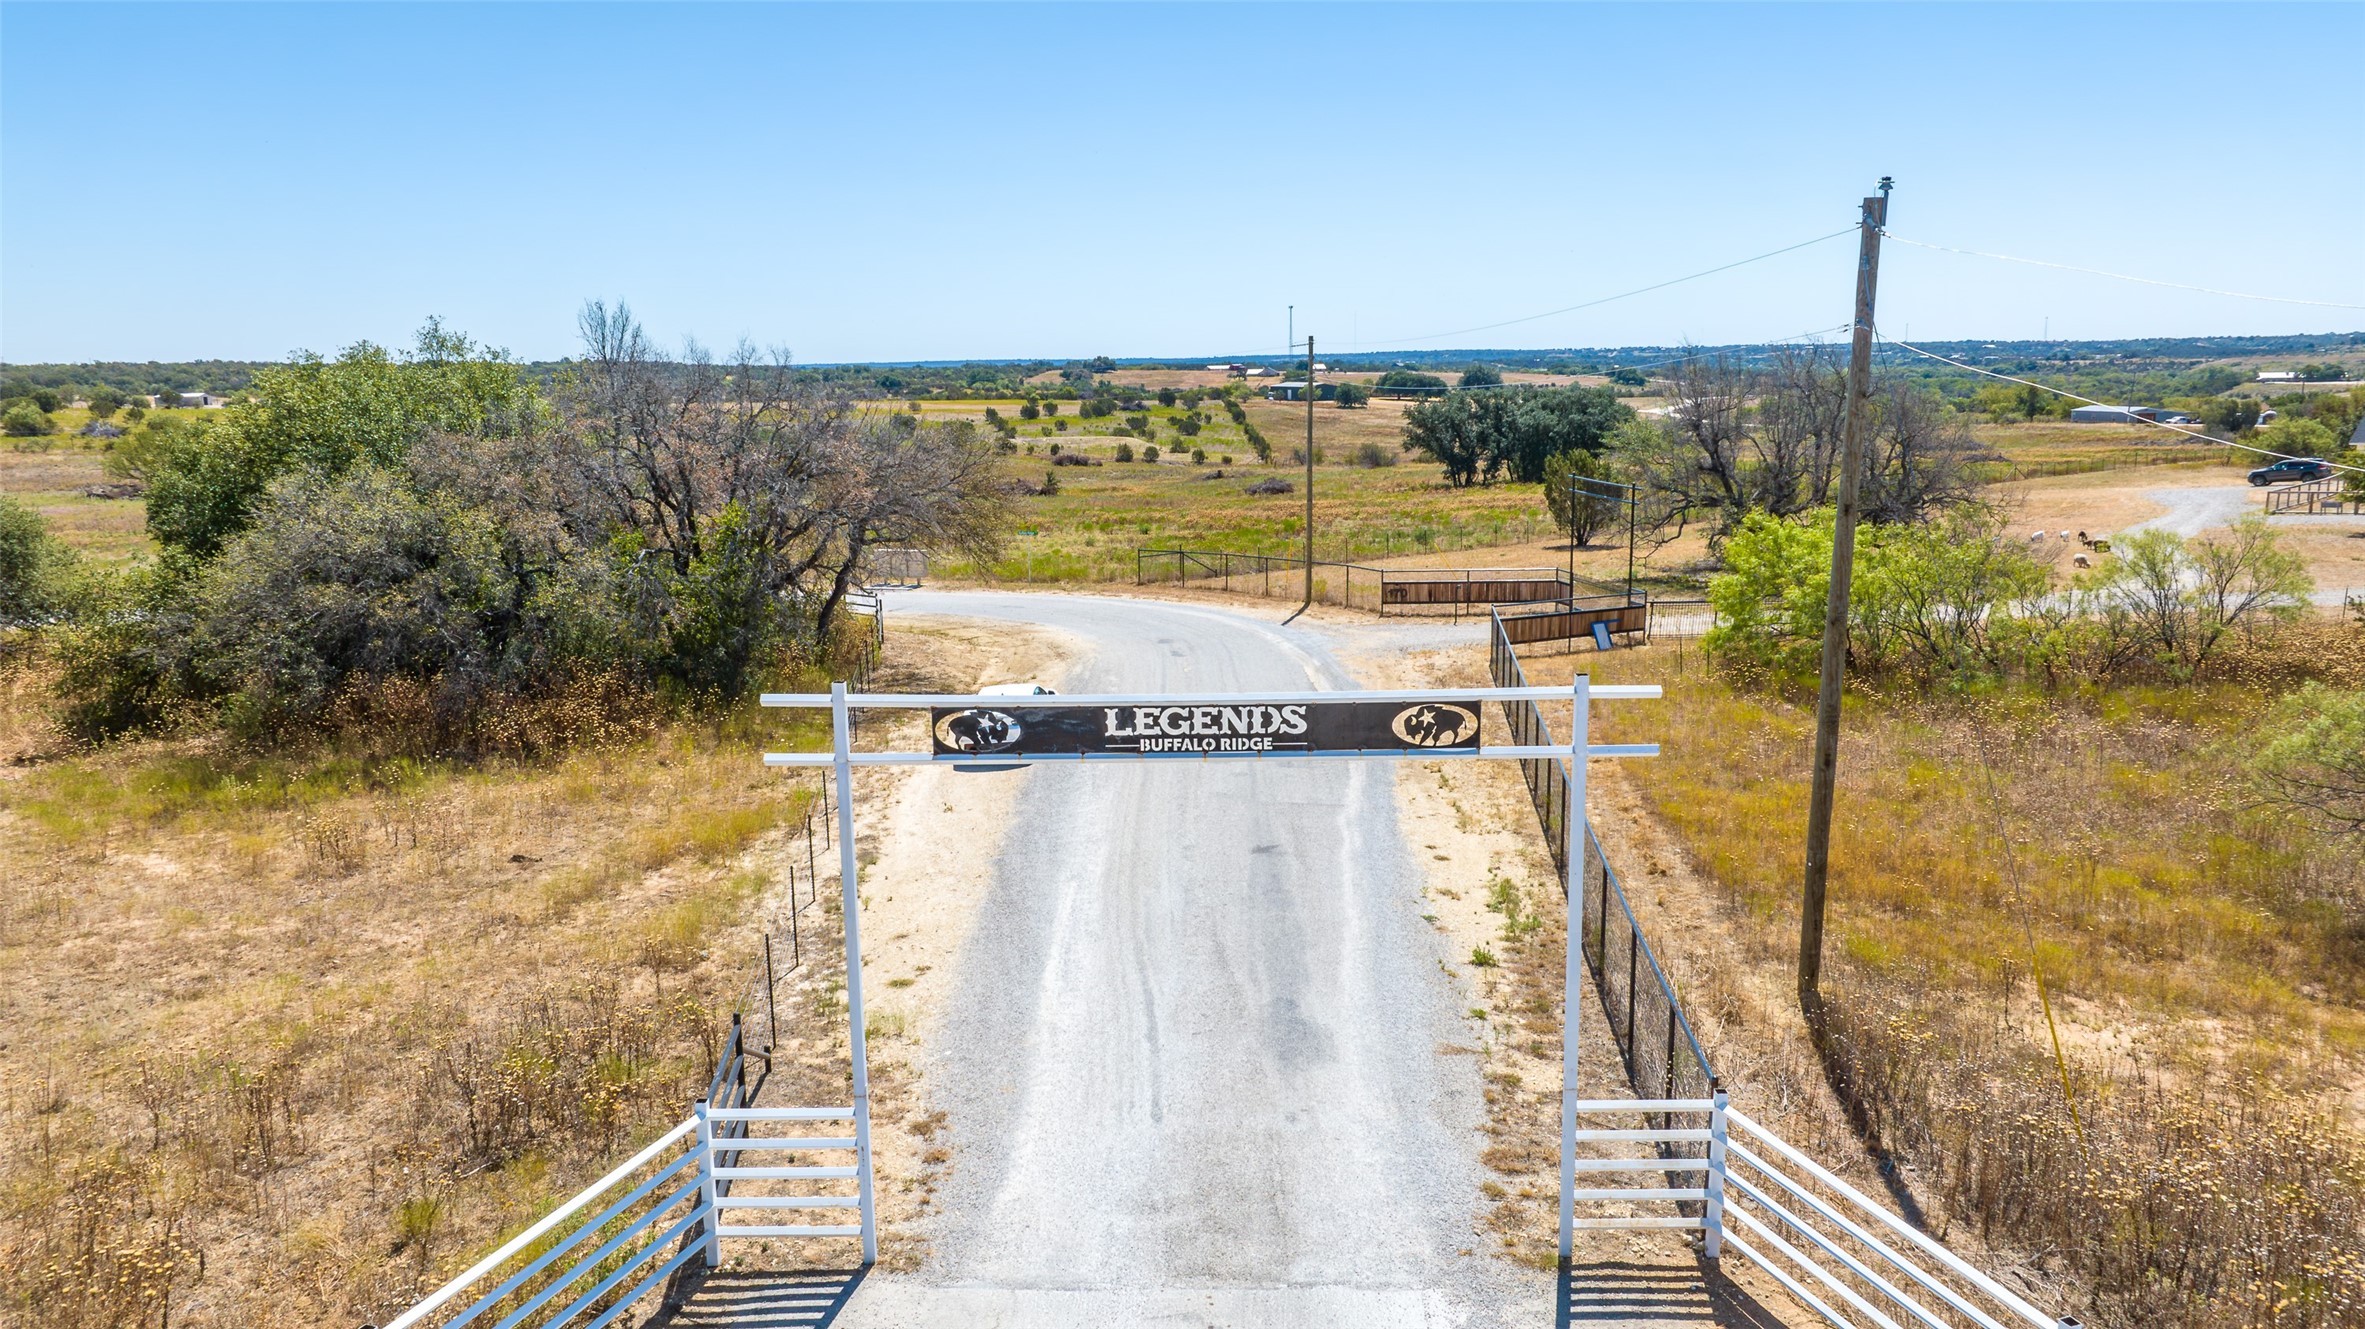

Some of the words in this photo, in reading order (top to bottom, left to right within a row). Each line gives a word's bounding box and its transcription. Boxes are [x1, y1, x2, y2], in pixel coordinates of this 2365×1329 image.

[1104, 705, 1308, 737] LEGENDS
[1139, 738, 1216, 752] BUFFALO
[1220, 737, 1273, 751] RIDGE
